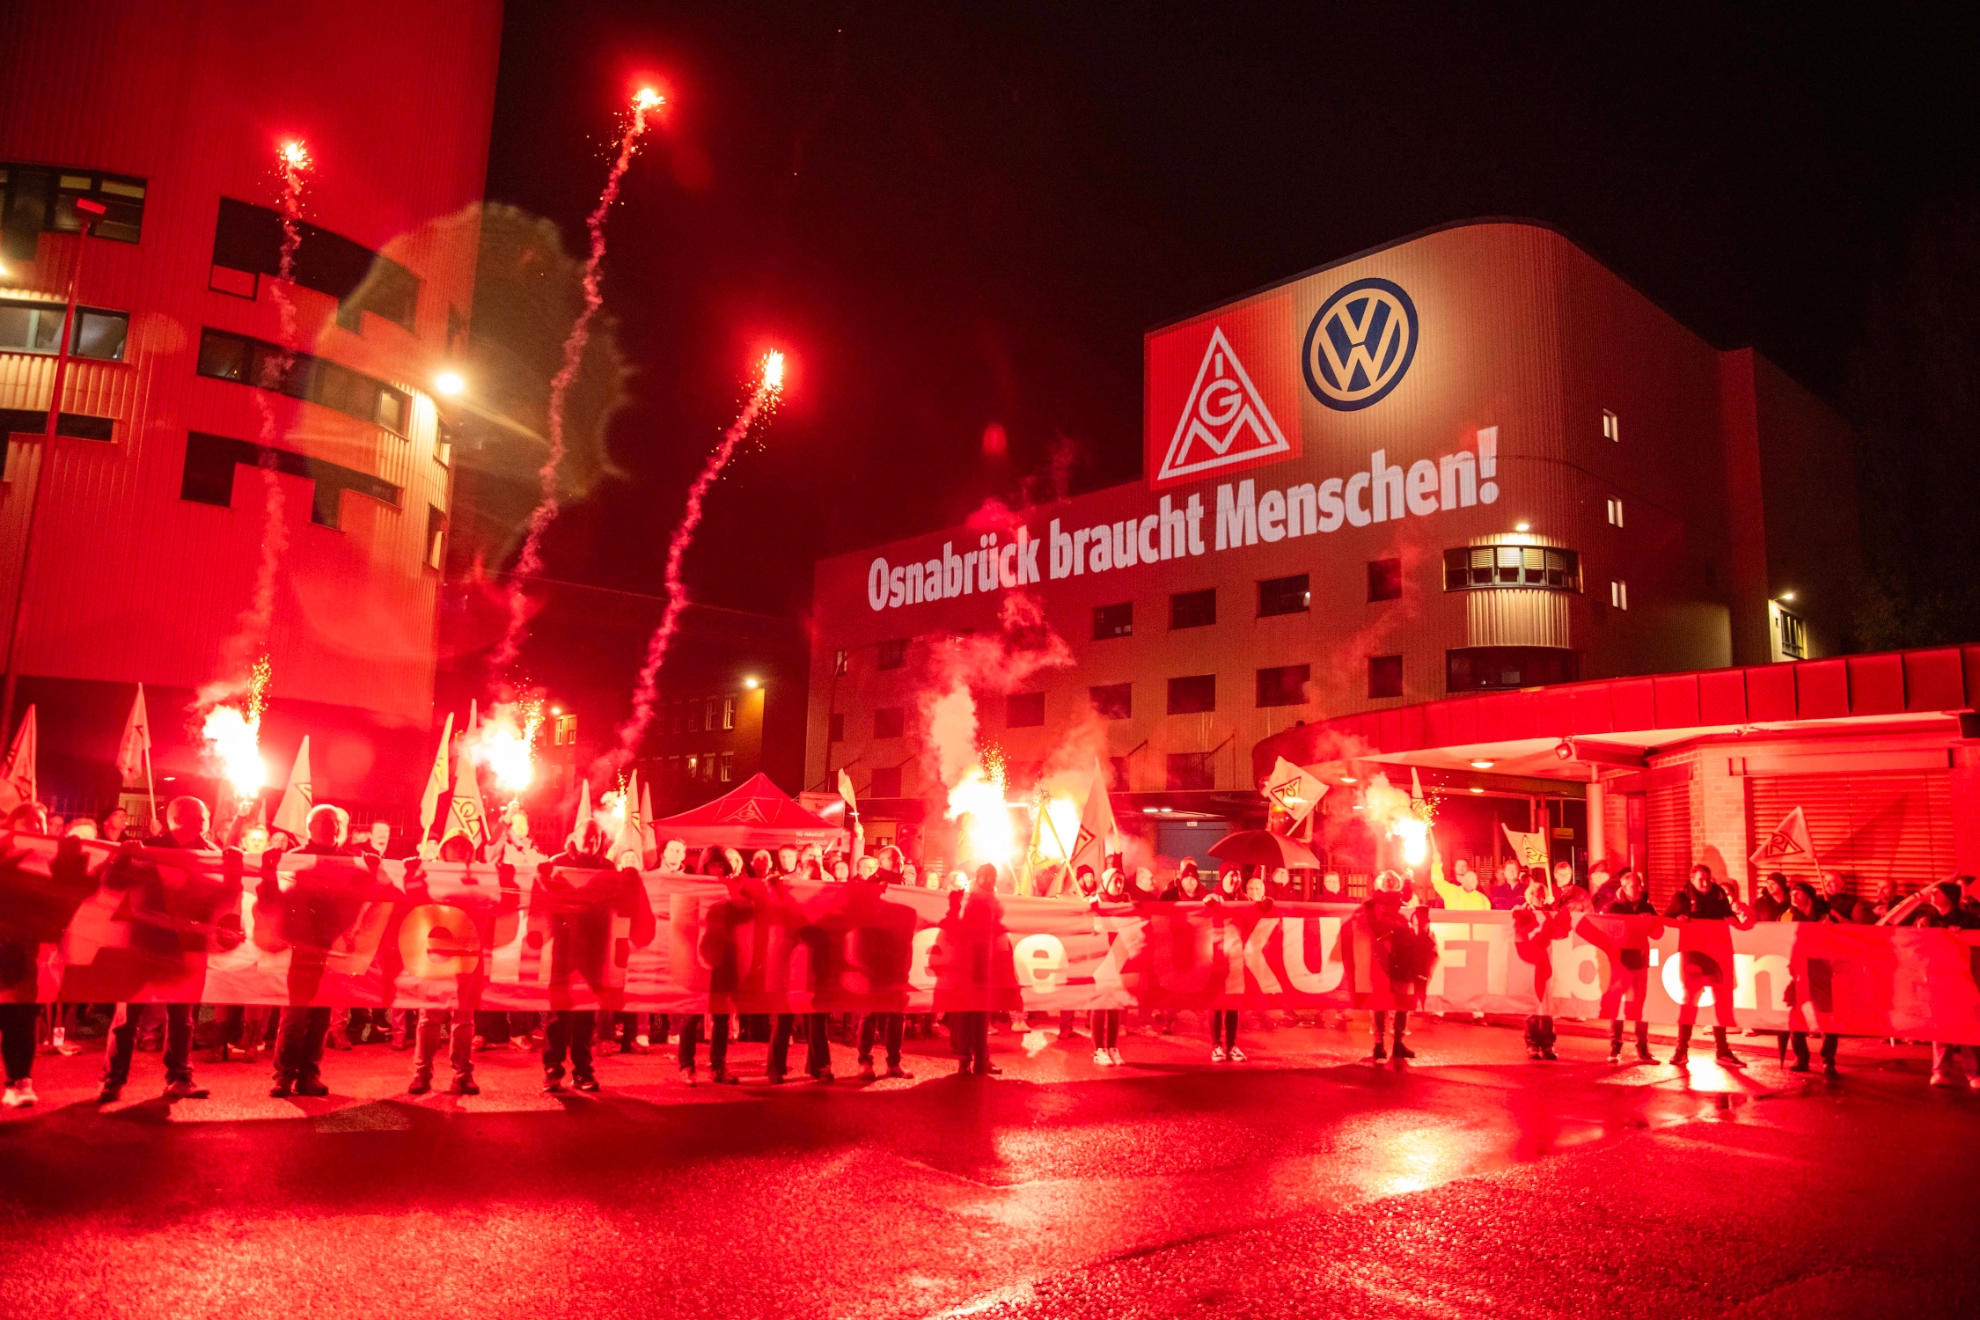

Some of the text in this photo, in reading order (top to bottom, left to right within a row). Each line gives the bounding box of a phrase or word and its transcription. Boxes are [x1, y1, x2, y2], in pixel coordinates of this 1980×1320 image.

[1312, 291, 1408, 399] VW
[867, 425, 1500, 612] Osnabrück braucht Menschen!
